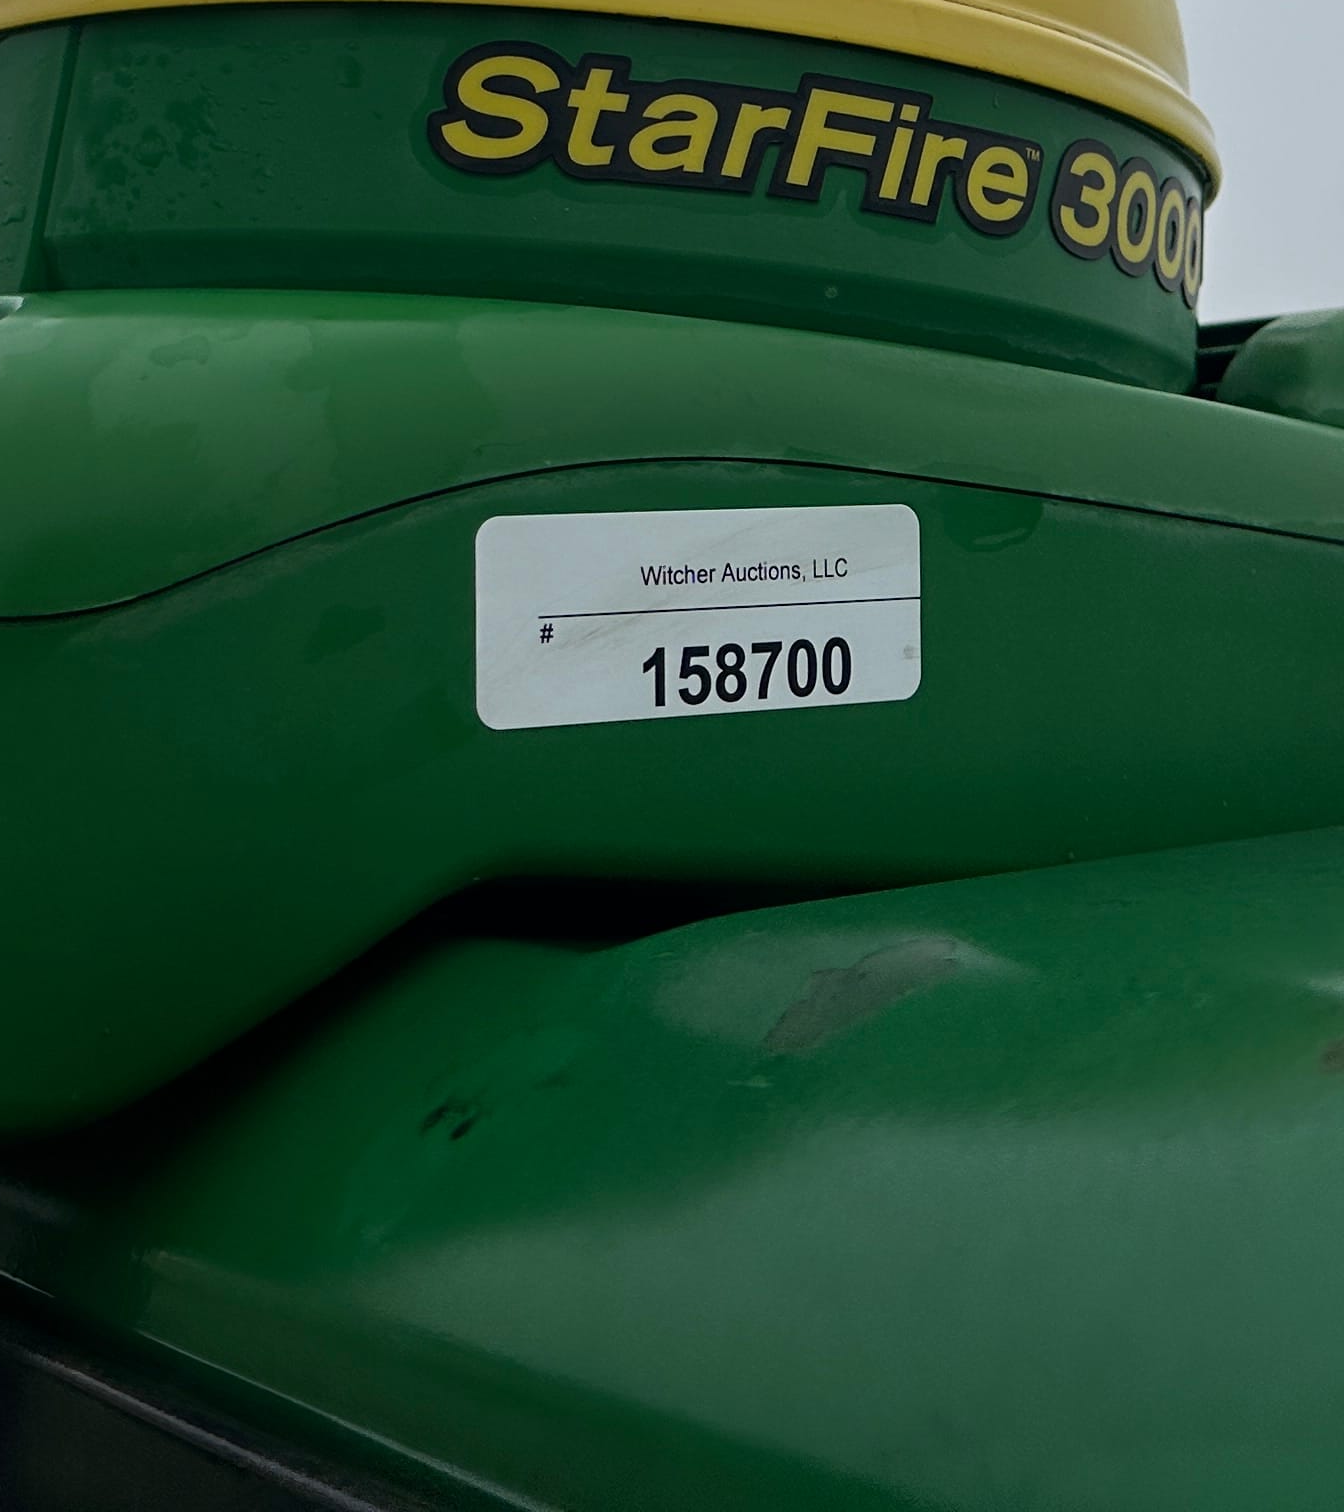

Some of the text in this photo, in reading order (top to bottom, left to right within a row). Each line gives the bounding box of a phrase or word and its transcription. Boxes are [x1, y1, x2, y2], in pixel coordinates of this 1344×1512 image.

[440, 54, 1030, 222] StarFire
[1059, 151, 1202, 298] 3000
[640, 557, 849, 587] Witcher Auctions, LLC
[641, 636, 853, 708] 158700
